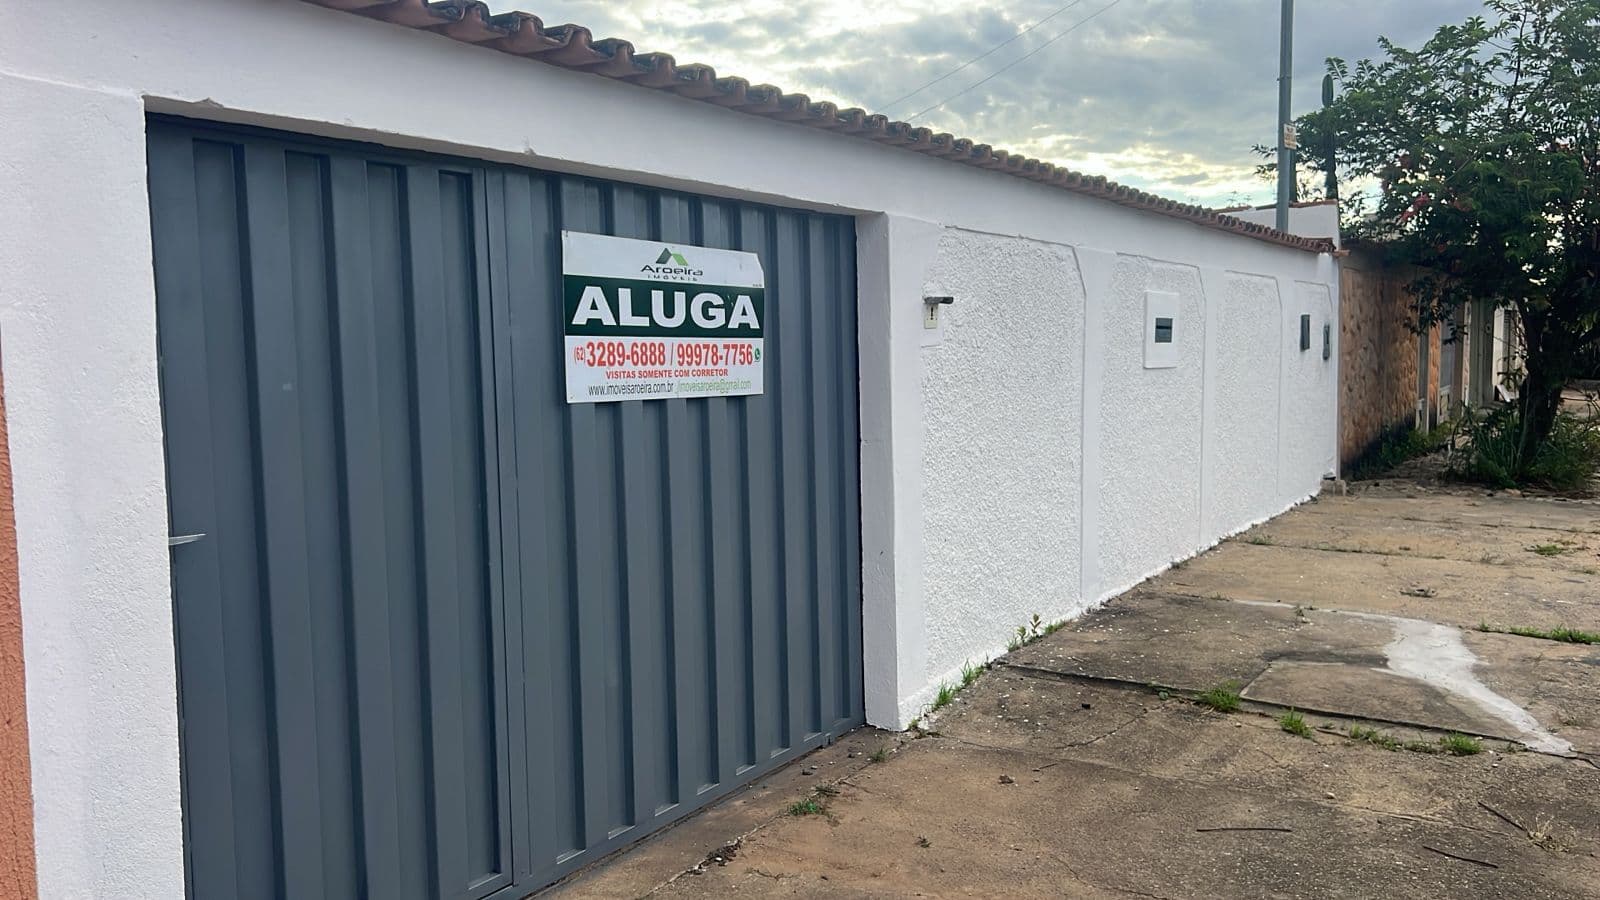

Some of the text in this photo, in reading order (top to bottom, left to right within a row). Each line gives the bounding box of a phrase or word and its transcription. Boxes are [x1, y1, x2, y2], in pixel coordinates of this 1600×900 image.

[641, 264, 704, 276] Aroeira
[571, 285, 760, 329] ALUGA
[586, 341, 666, 367] 3289-6888
[677, 343, 753, 366] 99978-7756
[606, 368, 728, 379] VISITAS SOMENTE COM CORRETOR
[588, 380, 674, 396] www.imoveisaroeira.com.br
